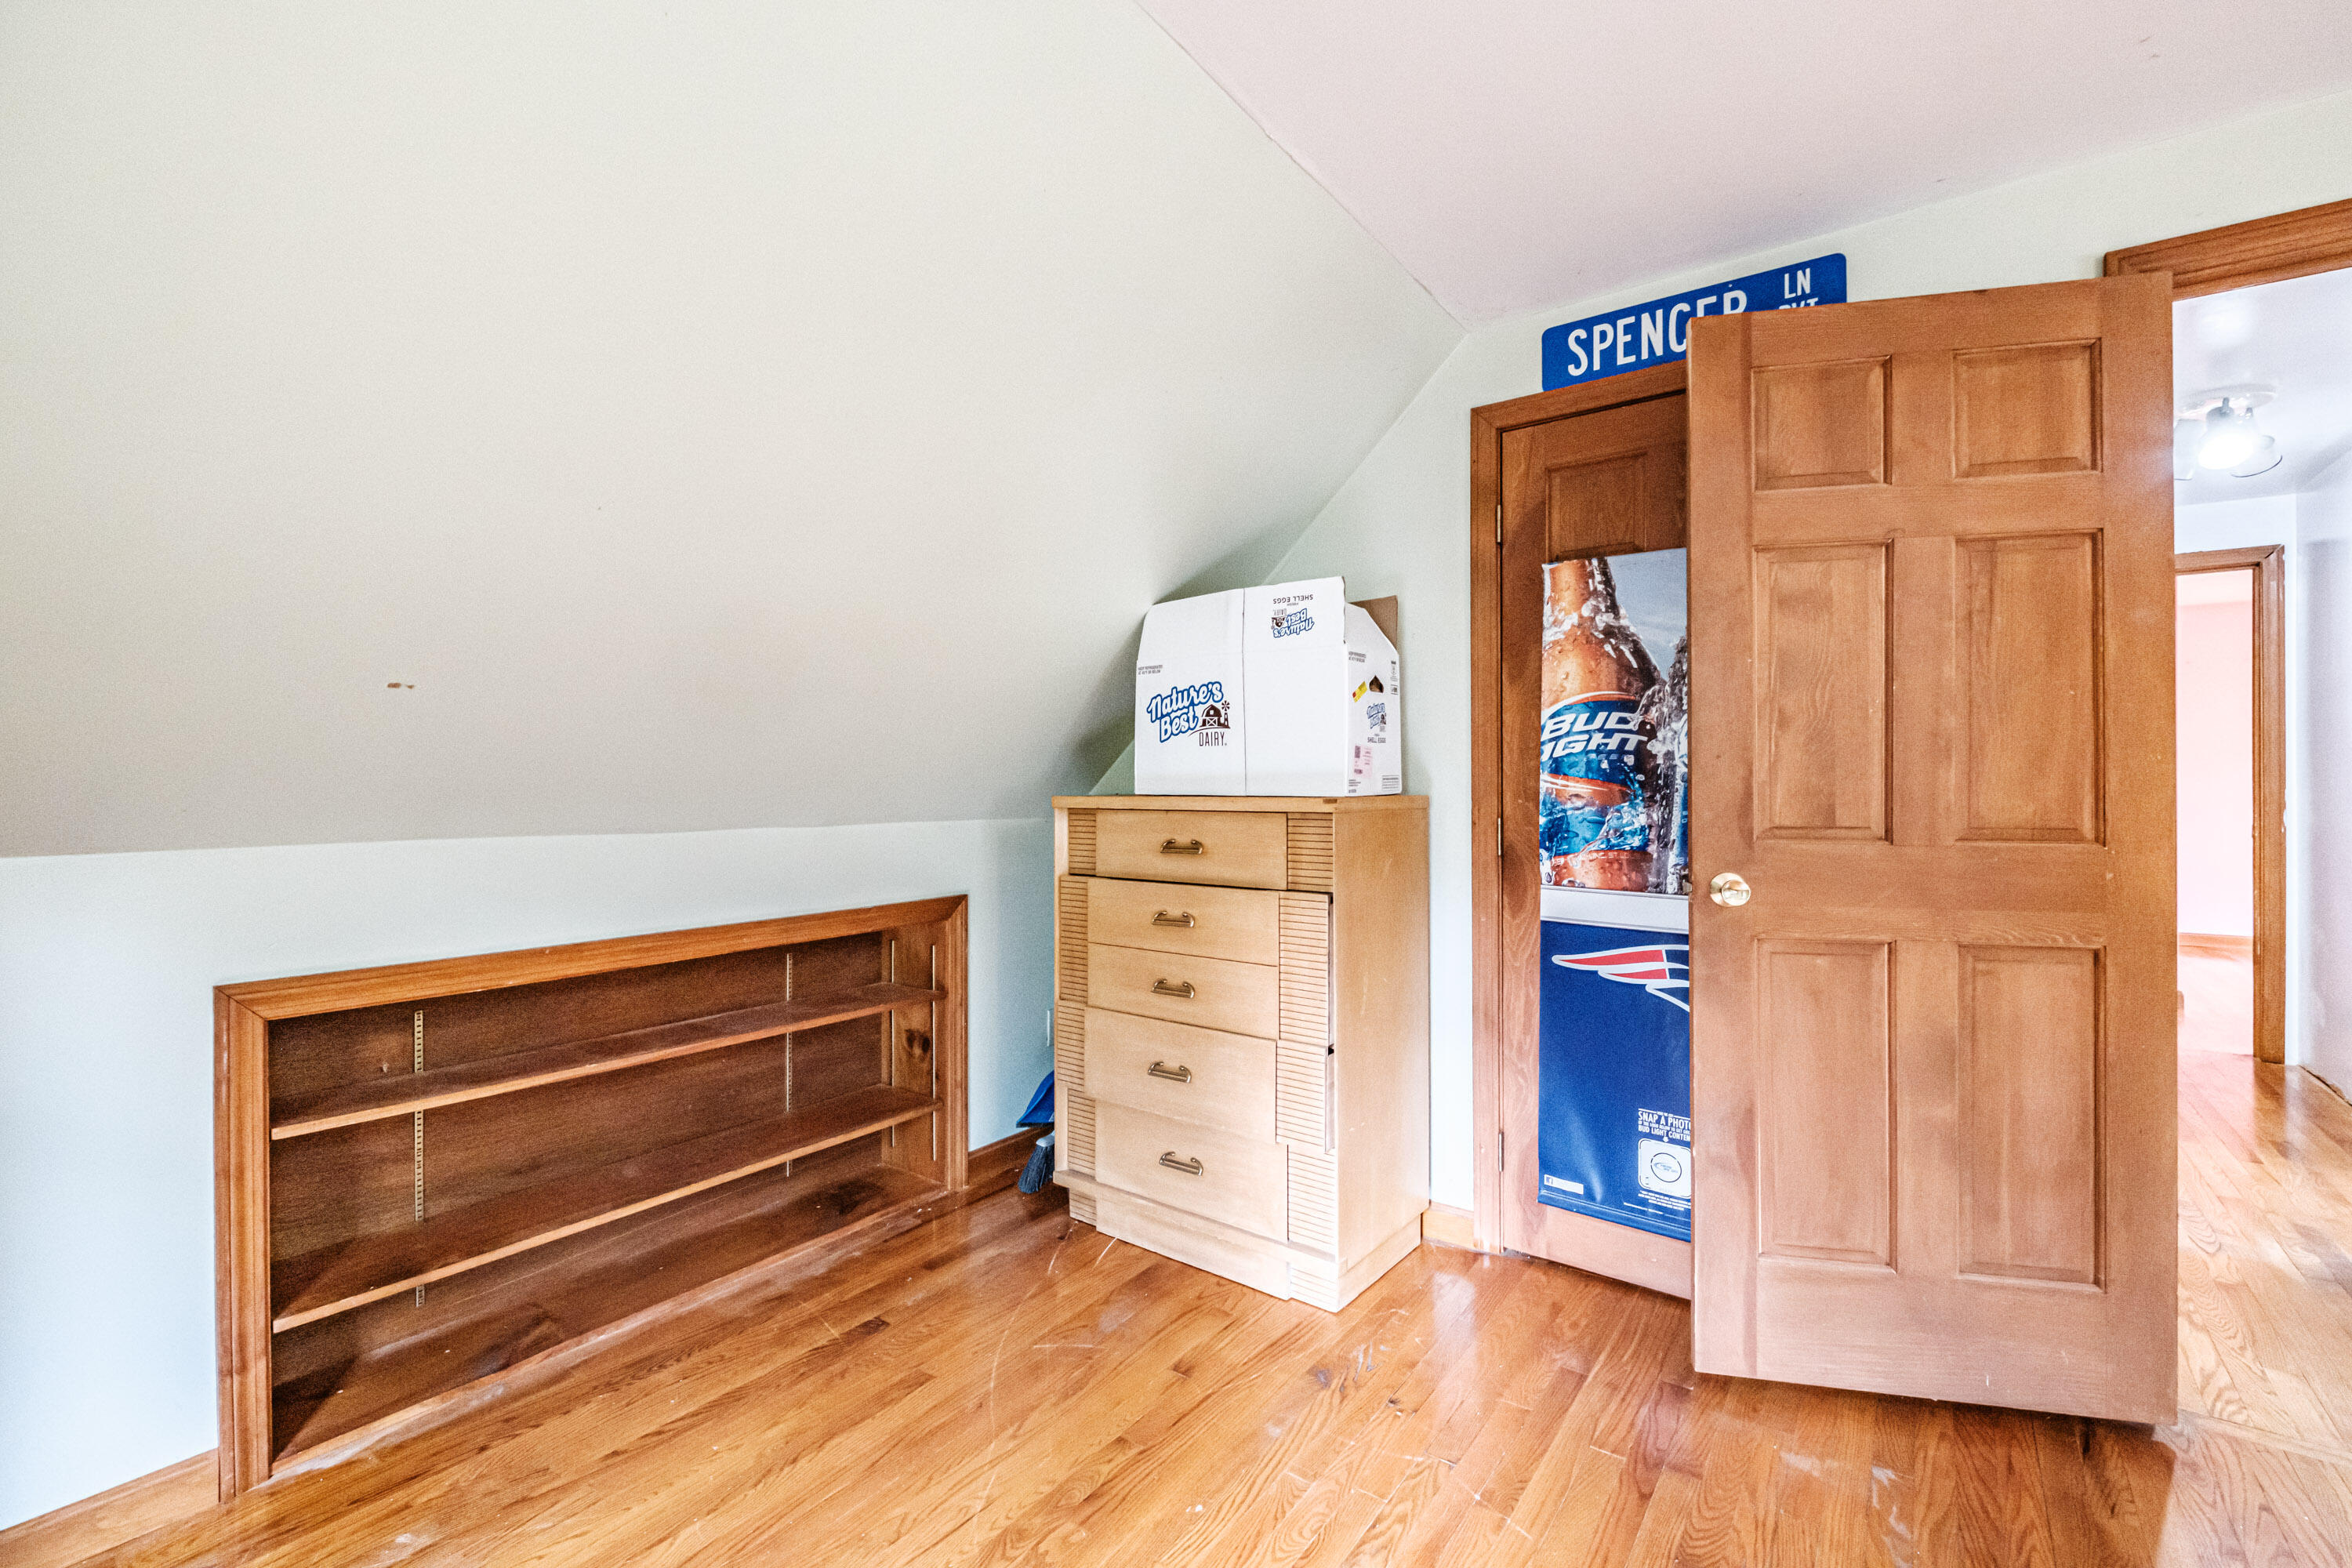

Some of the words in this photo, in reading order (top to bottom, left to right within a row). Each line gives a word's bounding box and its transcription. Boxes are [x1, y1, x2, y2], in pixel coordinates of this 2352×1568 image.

[1784, 267, 1811, 299] LN
[1286, 608, 1307, 627] Best
[1160, 706, 1199, 743] Best
[1541, 711, 1640, 741] BUD
[1199, 731, 1225, 746] DAIRY
[1541, 732, 1648, 762] IGHT
[1638, 1111, 1658, 1123] SNAP
[1660, 1115, 1666, 1126] A
[1638, 1124, 1650, 1133] BUD
[1651, 1127, 1667, 1137] LIGHT
[1668, 1131, 1690, 1142] CONTEN
